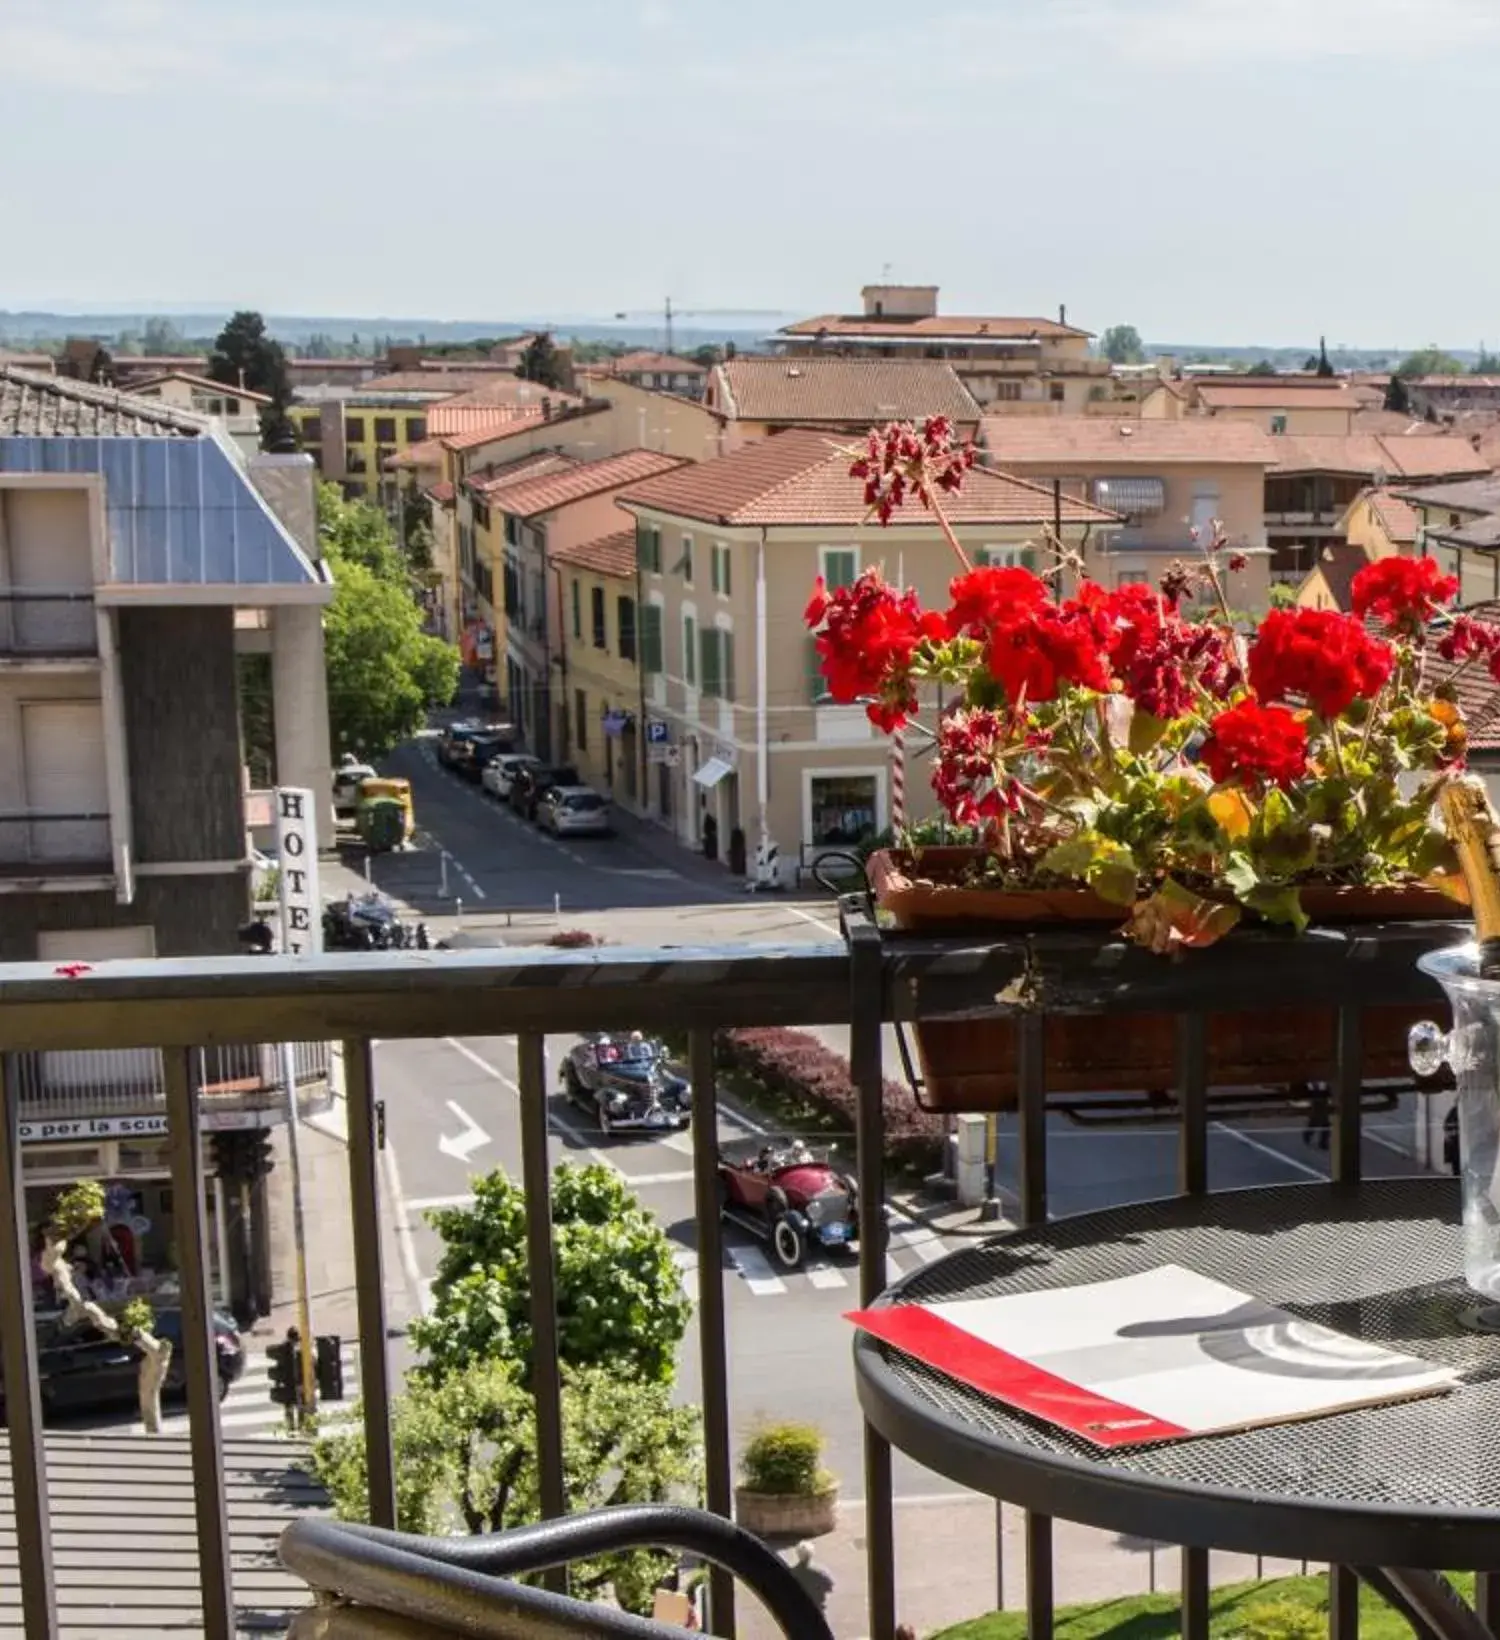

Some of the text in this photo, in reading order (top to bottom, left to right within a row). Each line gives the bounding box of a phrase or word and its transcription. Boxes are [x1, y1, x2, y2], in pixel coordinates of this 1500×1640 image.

[651, 724, 665, 740] P
[42, 1122, 81, 1136] per
[90, 1120, 110, 1132] la
